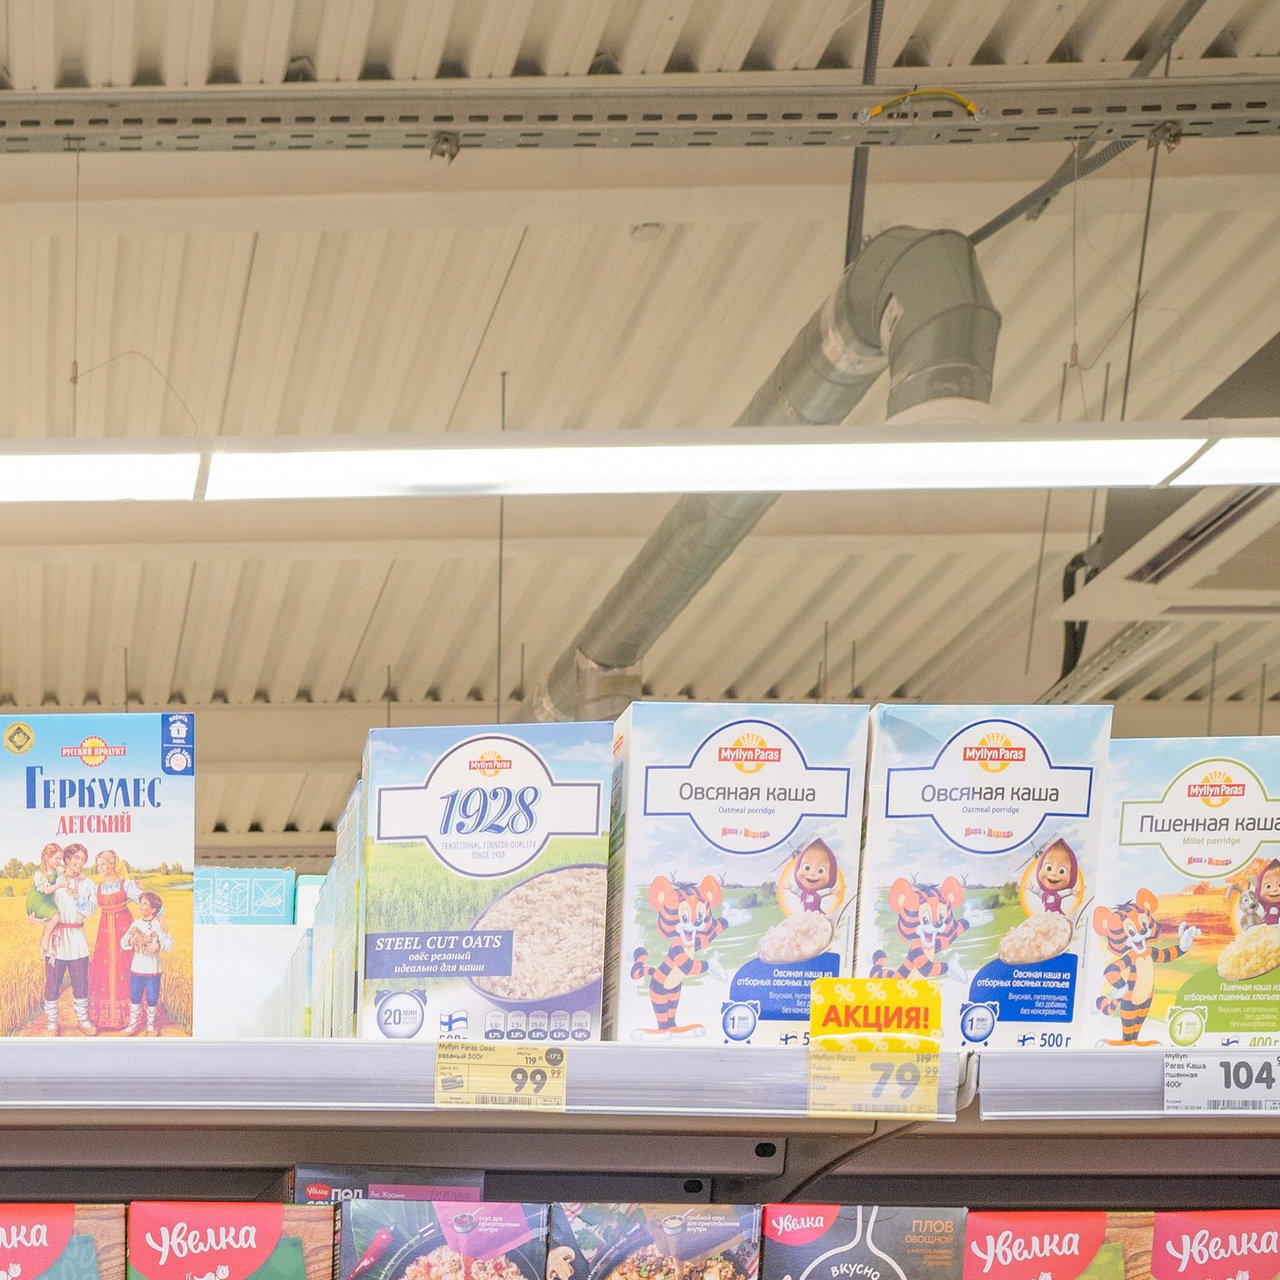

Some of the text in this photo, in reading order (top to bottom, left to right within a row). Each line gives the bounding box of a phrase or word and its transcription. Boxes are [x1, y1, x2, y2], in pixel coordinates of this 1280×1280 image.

[921, 784, 1059, 803] Овсяная каша
[439, 786, 542, 835] 1928
[962, 806, 1019, 816] Oatmeal porridge
[1139, 816, 1228, 833] Пшенная
[375, 935, 502, 950] STEEL CUT OATS
[821, 1005, 929, 1031] АКЦИЯ!
[1039, 1034, 1060, 1048] 500
[510, 1068, 547, 1093] 99
[869, 1063, 920, 1099] 79
[1220, 1061, 1276, 1090] 104
[912, 1220, 954, 1233] ПЛОВ
